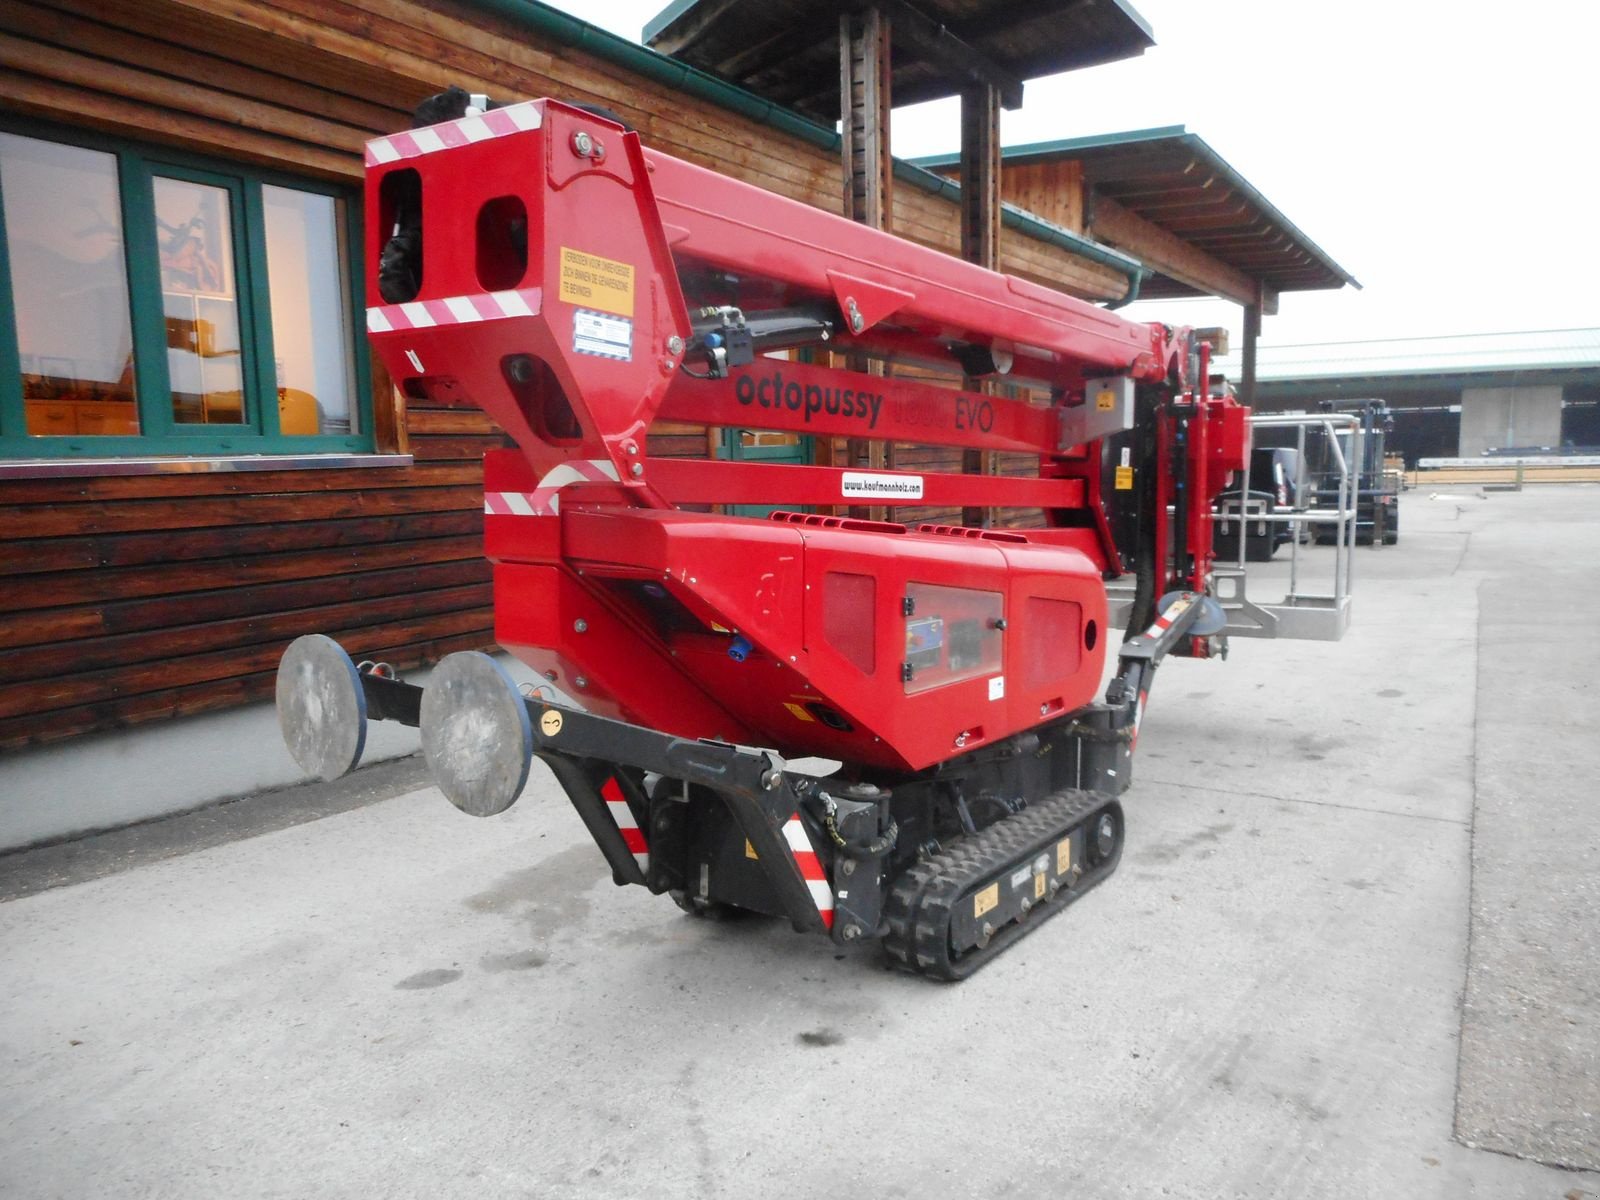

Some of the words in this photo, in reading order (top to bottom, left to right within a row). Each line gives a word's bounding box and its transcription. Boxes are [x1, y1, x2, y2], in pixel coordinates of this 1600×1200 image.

[736, 372, 882, 429] octopussy
[955, 397, 993, 432] EVO
[844, 480, 920, 492] www.kaufmannholz.com
